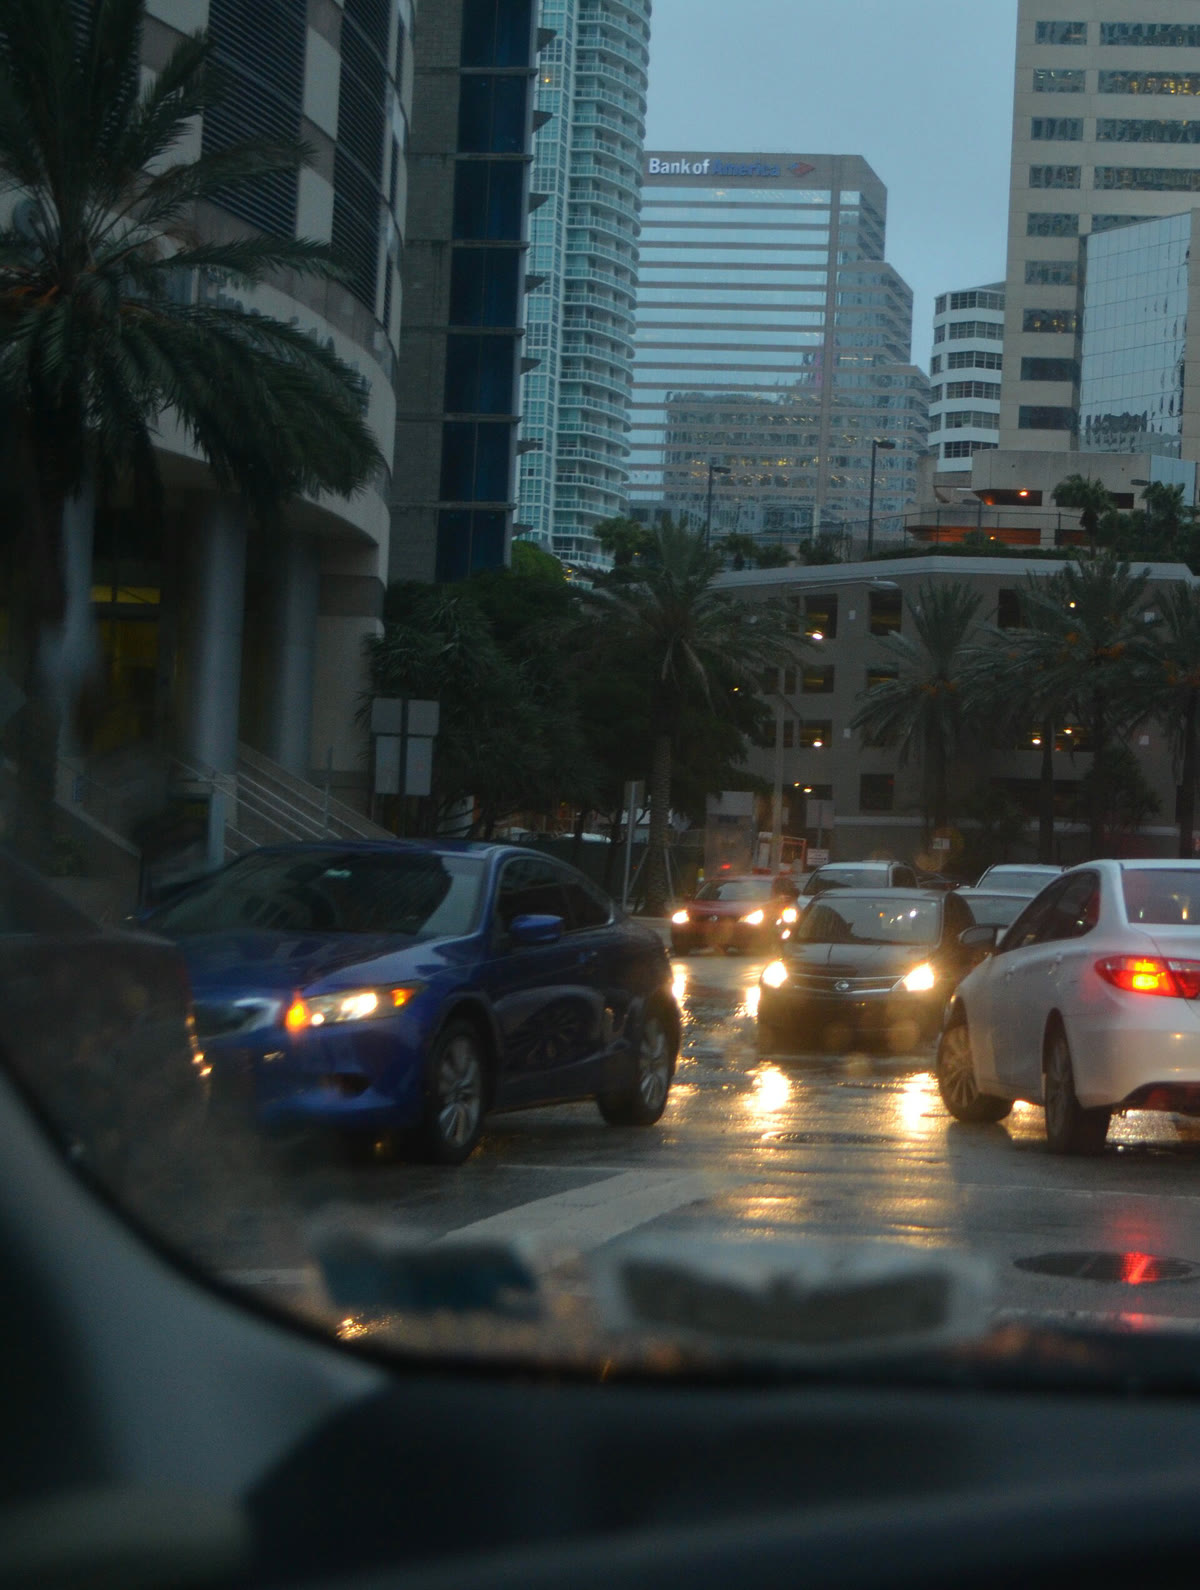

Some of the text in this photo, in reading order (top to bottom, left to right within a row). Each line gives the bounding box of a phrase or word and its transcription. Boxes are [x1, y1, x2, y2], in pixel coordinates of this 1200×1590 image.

[649, 158, 779, 177] Bank of America
